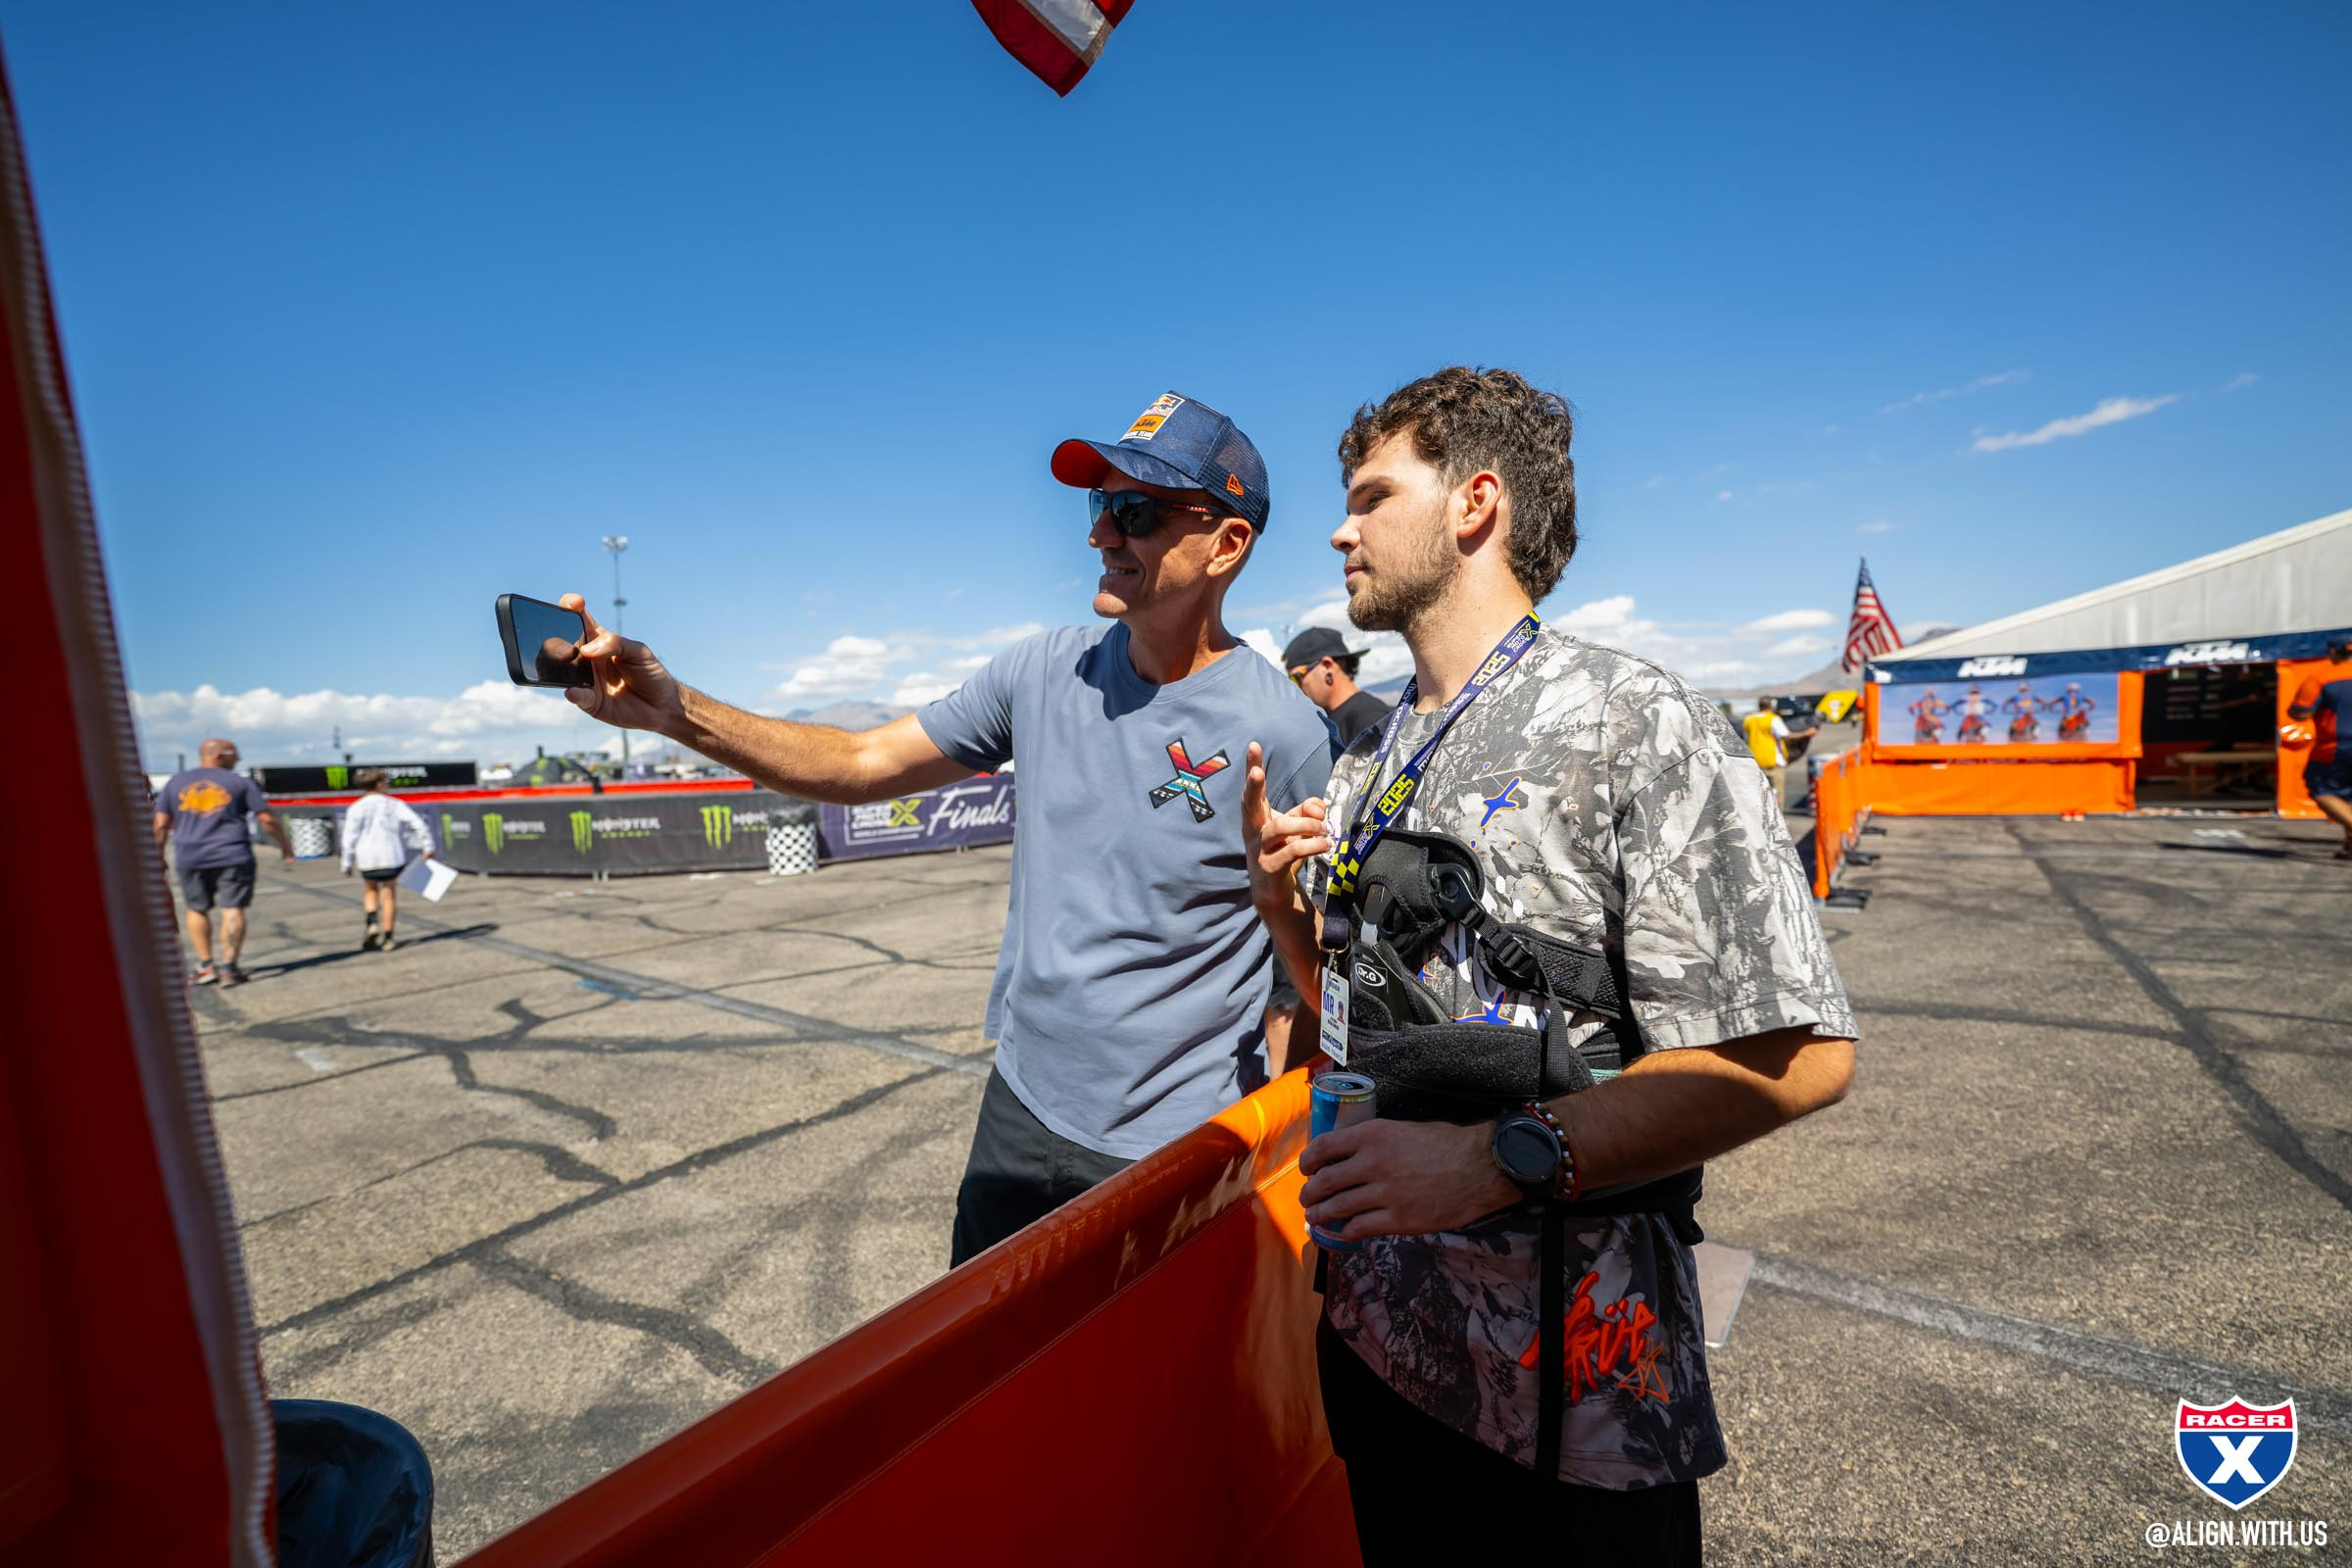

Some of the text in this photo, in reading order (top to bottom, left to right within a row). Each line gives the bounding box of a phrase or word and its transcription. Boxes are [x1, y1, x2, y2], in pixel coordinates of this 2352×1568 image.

[1471, 651, 1511, 686] 2025
[1957, 656, 2028, 677] KTM
[927, 785, 1010, 836] Finals
[1377, 773, 1415, 816] 2025
